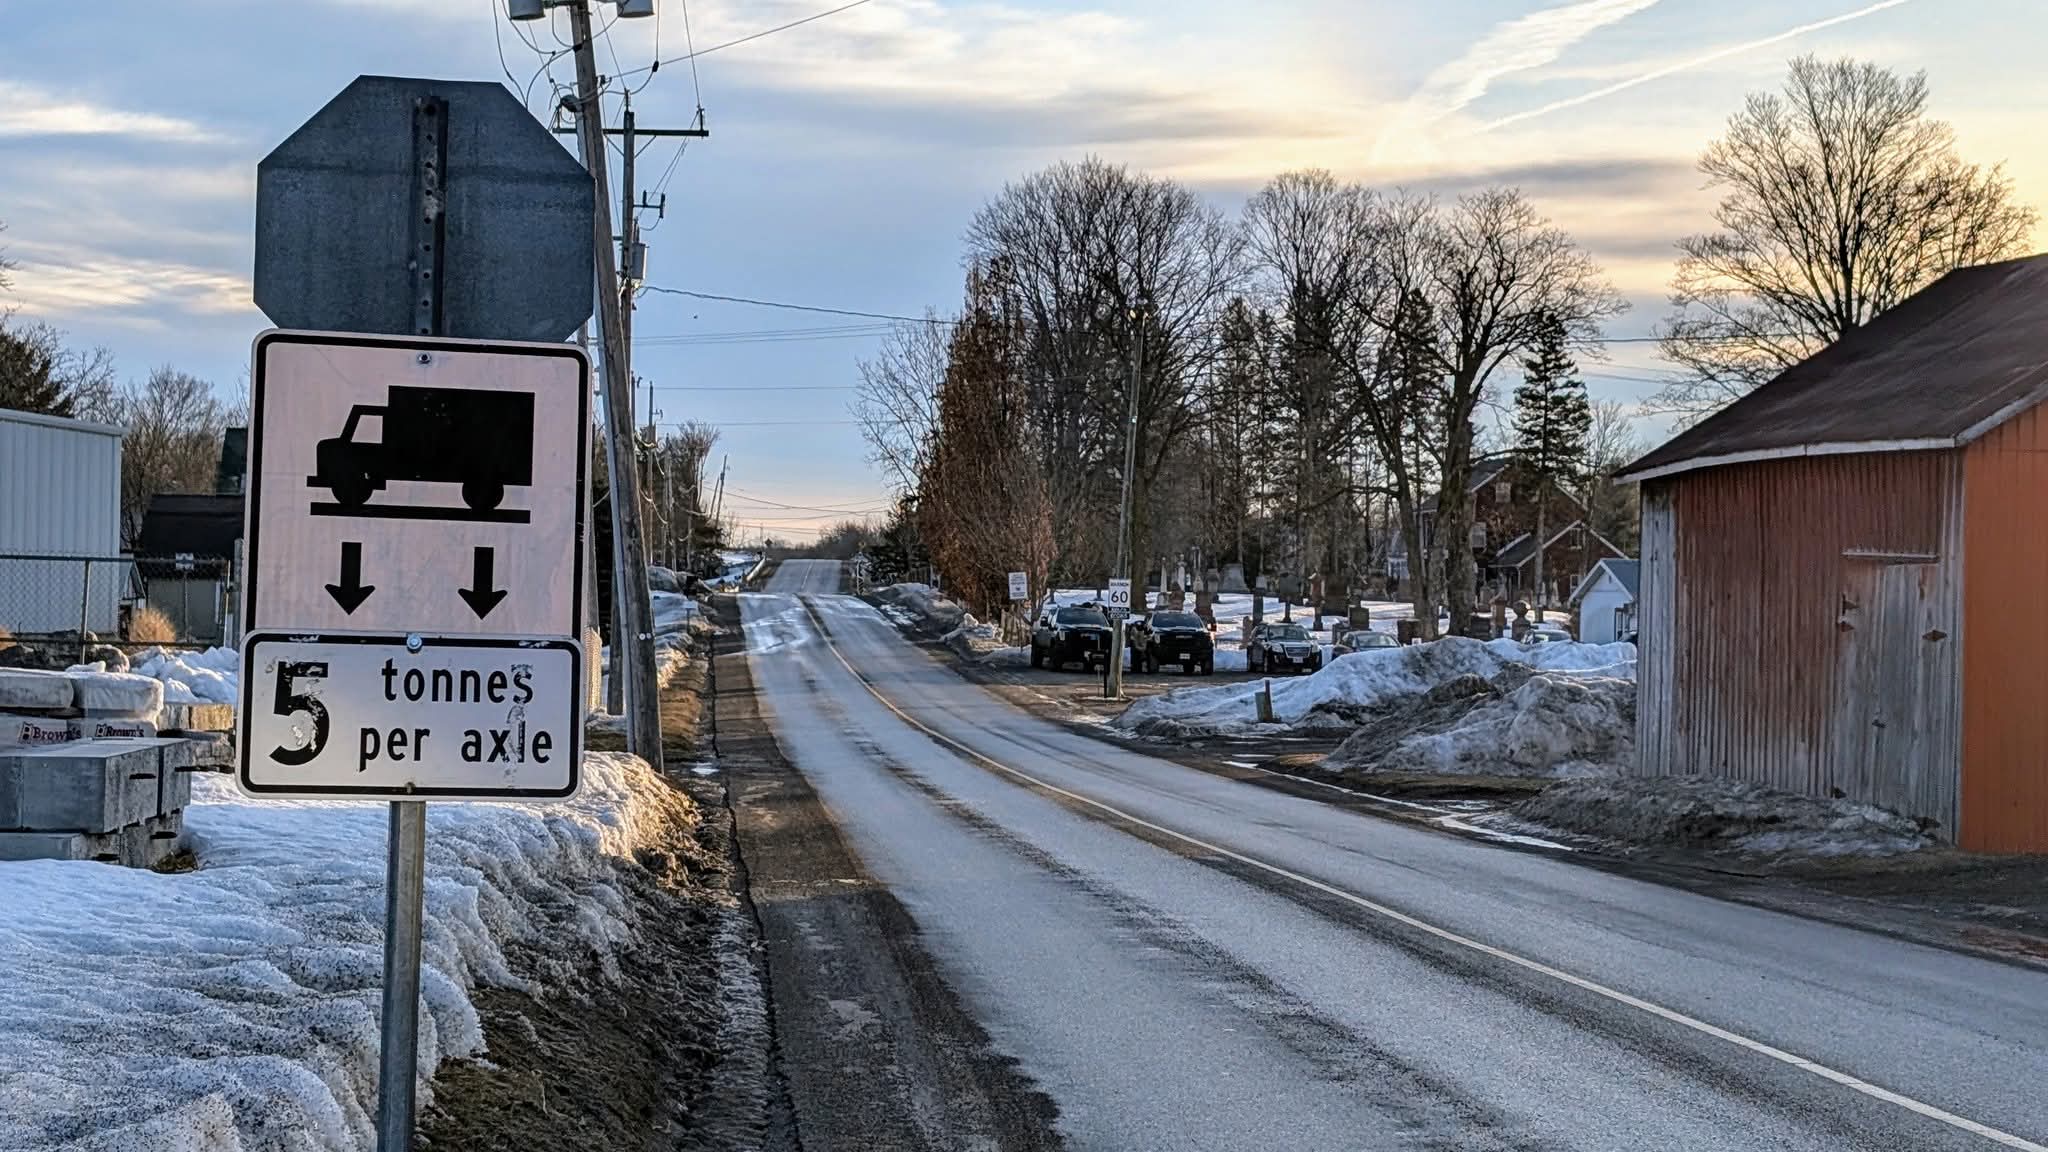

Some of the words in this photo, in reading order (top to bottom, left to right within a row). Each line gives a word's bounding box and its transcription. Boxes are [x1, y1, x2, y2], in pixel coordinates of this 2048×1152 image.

[1110, 590, 1129, 604] 60
[381, 658, 534, 704] tonnes
[33, 726, 82, 742] Brown's
[268, 660, 330, 765] 5
[358, 727, 430, 773] per
[460, 720, 553, 764] axle
